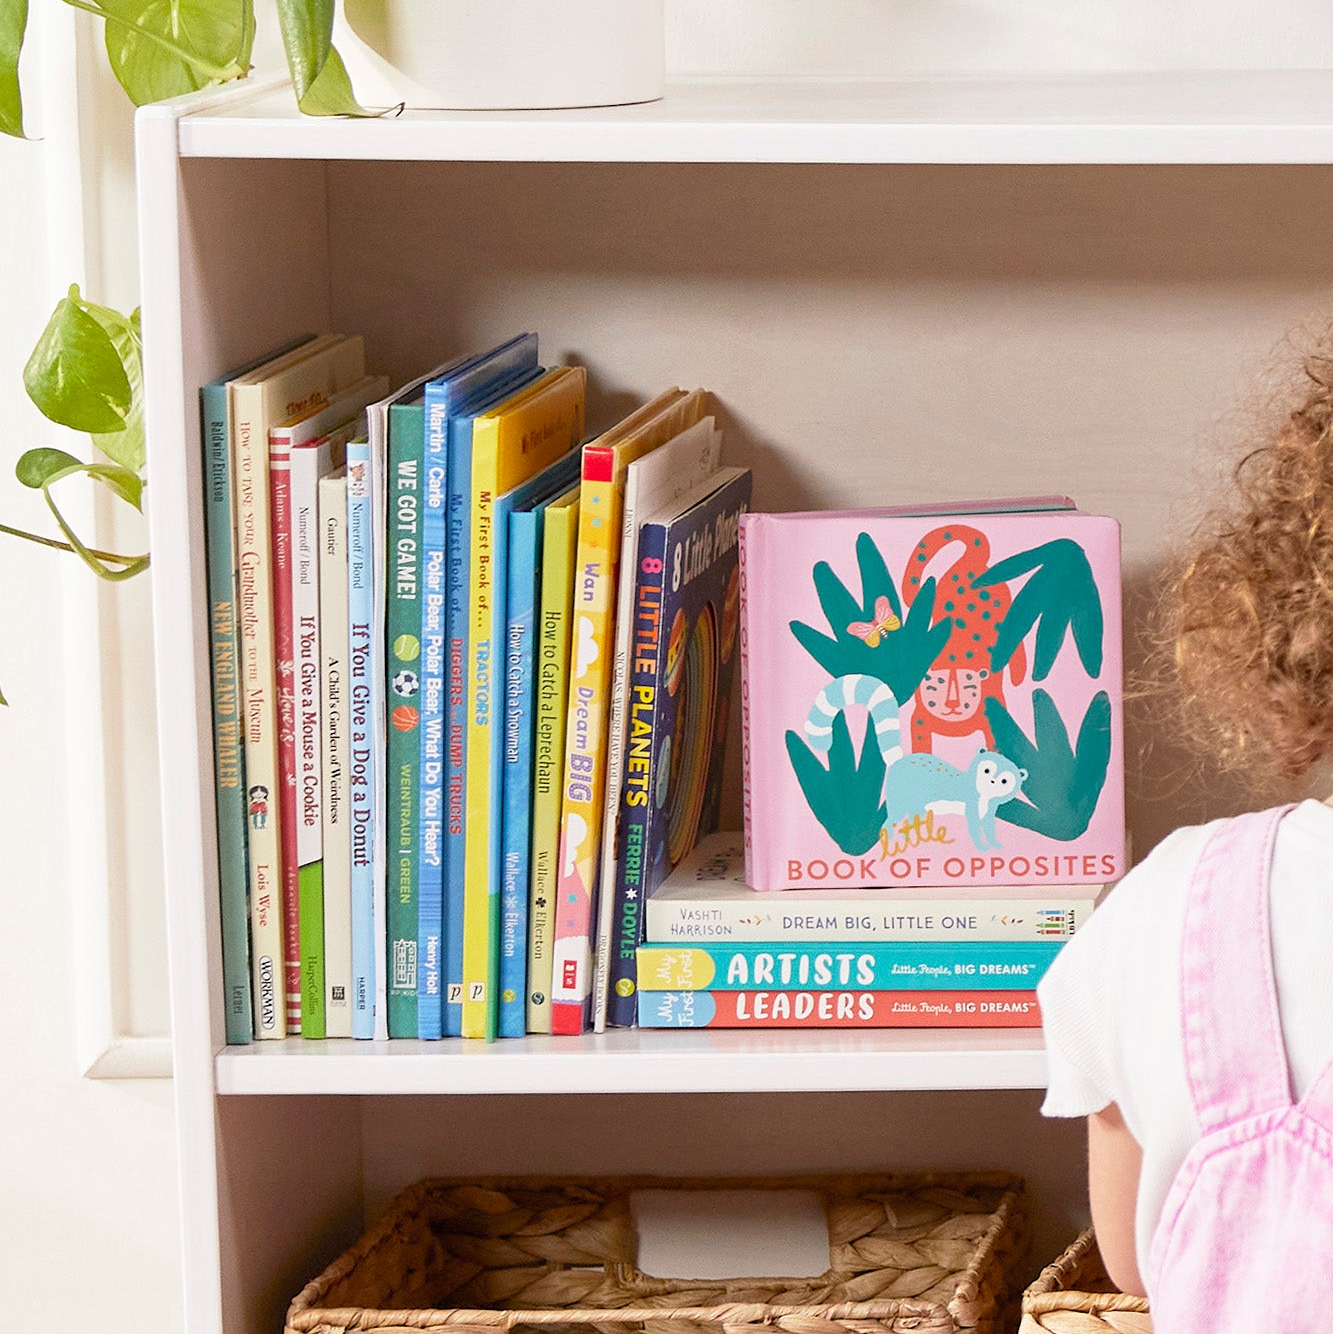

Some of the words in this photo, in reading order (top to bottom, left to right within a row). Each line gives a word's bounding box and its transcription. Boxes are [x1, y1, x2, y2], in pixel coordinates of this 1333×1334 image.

[429, 403, 445, 453] Martin
[243, 479, 252, 506] TAKE
[398, 459, 418, 490] WE
[428, 467, 445, 508] Carle
[275, 483, 287, 522] Adams
[397, 494, 418, 534] GOT
[451, 494, 462, 513] My
[479, 491, 491, 510] My
[244, 513, 254, 545] YOUR
[299, 507, 311, 553] Numeroff
[327, 517, 338, 556] Gautier
[353, 503, 364, 554] Numeroff
[451, 519, 462, 554] First
[480, 516, 491, 549] First
[277, 532, 289, 569] Keane
[641, 557, 663, 574] 8
[672, 542, 682, 592] 8
[683, 523, 713, 586] Little
[300, 560, 311, 585] Bond
[353, 562, 364, 589] Bond
[397, 538, 417, 600] GAME!
[427, 550, 445, 591] Polar
[451, 558, 462, 592] Book
[480, 555, 490, 589] Book
[583, 563, 600, 601] Wan
[241, 551, 260, 639] Grandmother
[425, 594, 443, 631] Bear,
[478, 595, 489, 627] of...
[215, 601, 232, 635] NEW
[301, 616, 315, 629] If
[353, 623, 369, 637] If
[545, 611, 562, 641] How
[635, 585, 662, 675] LITTLE
[301, 631, 315, 658] You
[427, 635, 443, 674] Polar
[509, 624, 525, 650] How
[544, 645, 557, 658] to
[328, 657, 339, 667] A
[353, 643, 370, 677] You
[451, 638, 463, 706] DIGGERS
[509, 652, 522, 663] to
[215, 642, 235, 715] ENGLAND
[301, 663, 316, 696] Give
[328, 670, 340, 709] Child's
[424, 678, 443, 715] Bear,
[475, 639, 490, 726] TRACTORS
[508, 666, 524, 697] Catch
[542, 663, 559, 699] Catch
[249, 688, 264, 744] Museum
[303, 699, 312, 708] a
[353, 684, 370, 725] Give
[508, 699, 519, 707] a
[541, 703, 553, 711] a
[576, 687, 594, 750] Dream
[302, 711, 317, 759] Mouse
[329, 711, 341, 752] Garden
[354, 732, 366, 742] a
[426, 718, 442, 758] What
[450, 725, 463, 768] DUMP
[507, 710, 523, 763] Snowman
[626, 685, 655, 808] PLANETS
[218, 721, 238, 788] WHALER
[304, 763, 313, 771] a
[330, 754, 341, 767] of
[351, 749, 370, 786] Dog
[538, 716, 557, 794] Leprechaun
[425, 762, 441, 784] Do
[569, 753, 593, 802] BIG
[304, 775, 319, 826] Cookie
[330, 768, 341, 824] Weirdness
[354, 793, 366, 802] a
[400, 764, 412, 845] WEINTRAUB
[425, 788, 441, 816] You
[450, 773, 463, 835] TRUCKS
[353, 809, 371, 867] Donut
[424, 821, 441, 867] Hear?
[879, 809, 956, 861] little
[505, 852, 520, 892] Wallace
[624, 823, 643, 885] FERRIE
[788, 859, 877, 880] BOOK
[890, 858, 931, 879] OF
[943, 854, 1116, 878] OPPOSITES
[257, 864, 269, 891] Lois
[400, 857, 412, 904] GREEN
[538, 851, 549, 894] Wallace
[257, 894, 271, 926] Wyse
[680, 908, 722, 920] VASHTI
[782, 917, 838, 929] DREAM
[845, 917, 876, 931] BIG,
[883, 917, 934, 929] LITTLE
[941, 916, 978, 929] ONE
[504, 912, 519, 957] Elkerton
[534, 911, 546, 960] Elkerton
[620, 902, 638, 960] DOYLE
[671, 923, 732, 937] HARRISON
[424, 936, 438, 969] Henry
[656, 954, 677, 983] My
[678, 950, 693, 987] First
[727, 953, 876, 985] ARTISTS
[427, 971, 438, 995] Holt
[891, 964, 917, 976] Little
[919, 964, 952, 978] People,
[954, 964, 976, 975] BIG
[260, 960, 274, 1028] WORKMAN
[657, 992, 679, 1022] My
[678, 991, 694, 1026] First
[736, 992, 875, 1020] LEADERS
[891, 1002, 918, 1013] Little
[920, 1002, 953, 1016] People,
[955, 1002, 976, 1013] BIG
